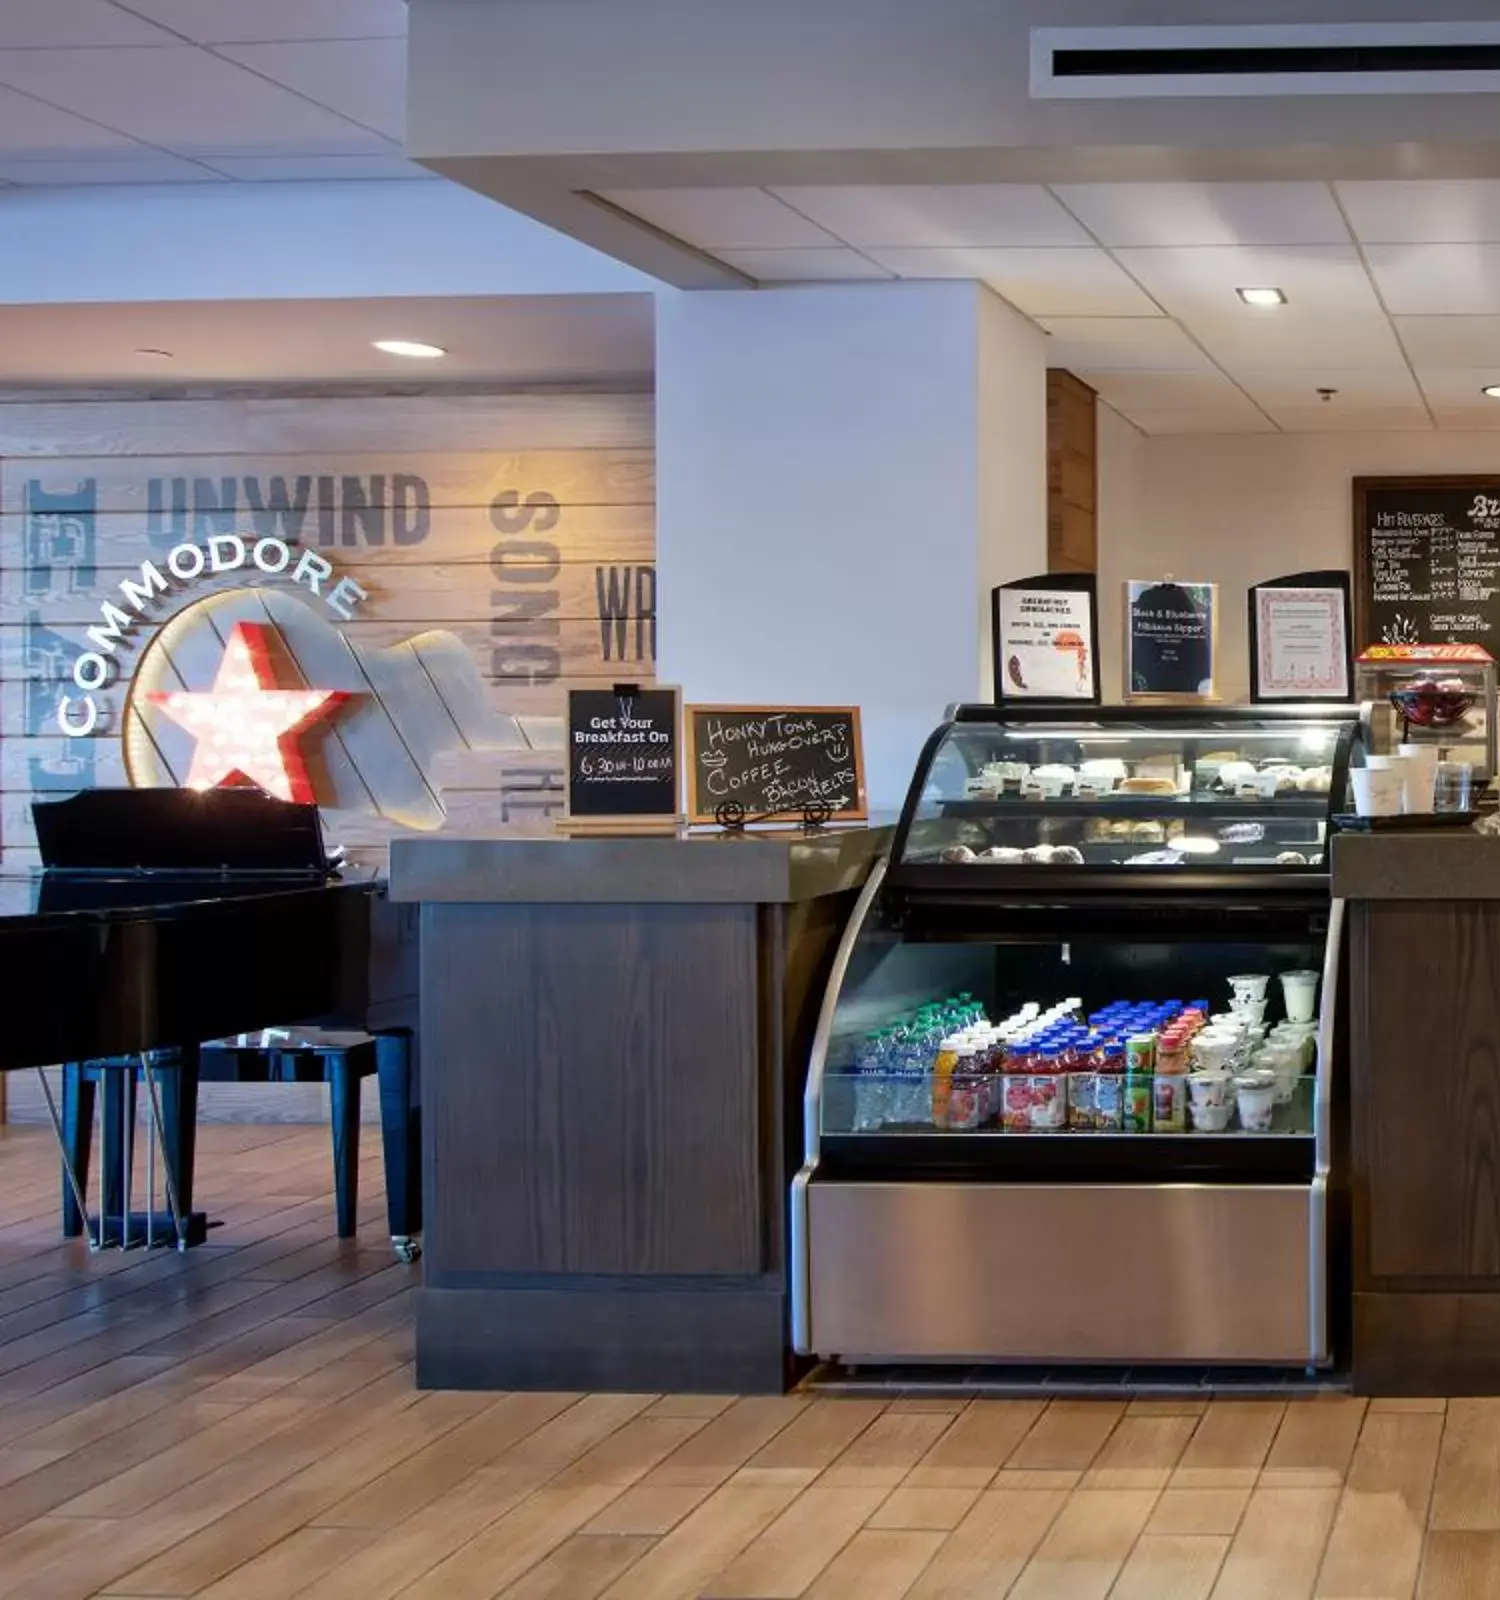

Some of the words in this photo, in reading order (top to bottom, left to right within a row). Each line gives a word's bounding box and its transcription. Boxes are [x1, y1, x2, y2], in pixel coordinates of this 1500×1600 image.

[147, 474, 431, 547] UNWIND
[489, 489, 561, 687] SONG
[58, 534, 369, 738] COMMODORE
[575, 731, 646, 743] Breakfast
[649, 731, 669, 743] On
[590, 717, 617, 729] Get
[620, 717, 653, 729] Your
[706, 720, 767, 748] HONKY
[767, 714, 817, 738] TONK
[707, 758, 791, 796] COFFEE
[762, 771, 818, 803] BACON
[808, 768, 855, 798] HELPS
